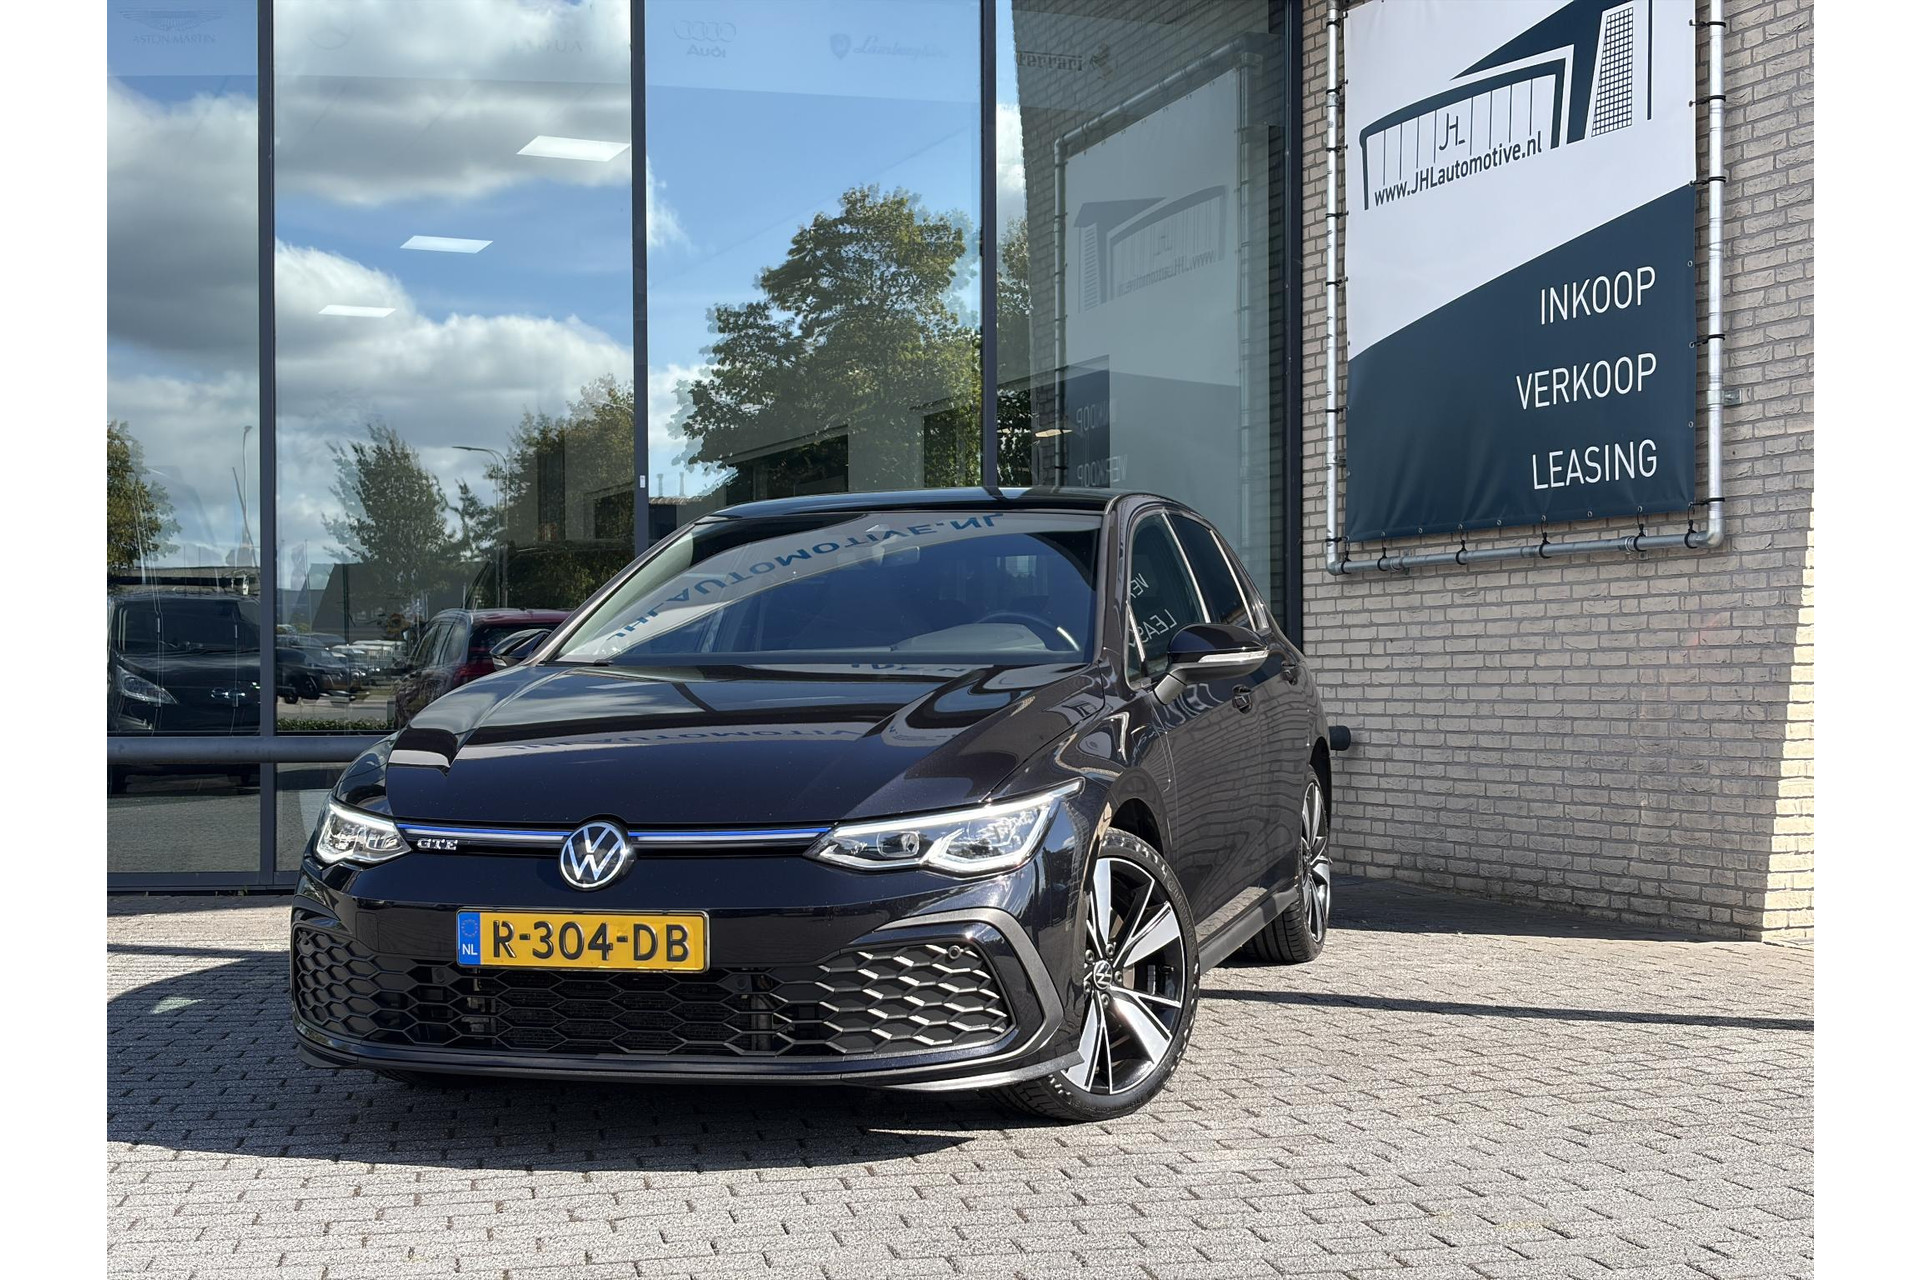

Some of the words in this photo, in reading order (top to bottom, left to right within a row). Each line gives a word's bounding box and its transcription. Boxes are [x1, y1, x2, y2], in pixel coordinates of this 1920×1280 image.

[1016, 50, 1083, 72] Ferrari
[1374, 130, 1542, 206] www.JHLautomotive.nl
[1540, 265, 1656, 325] INKOOP
[1515, 352, 1657, 410] VERKOOP
[1532, 438, 1657, 490] LEASING
[416, 837, 459, 851] GTE
[462, 943, 478, 956] NL
[492, 919, 690, 963] R-304-DB
